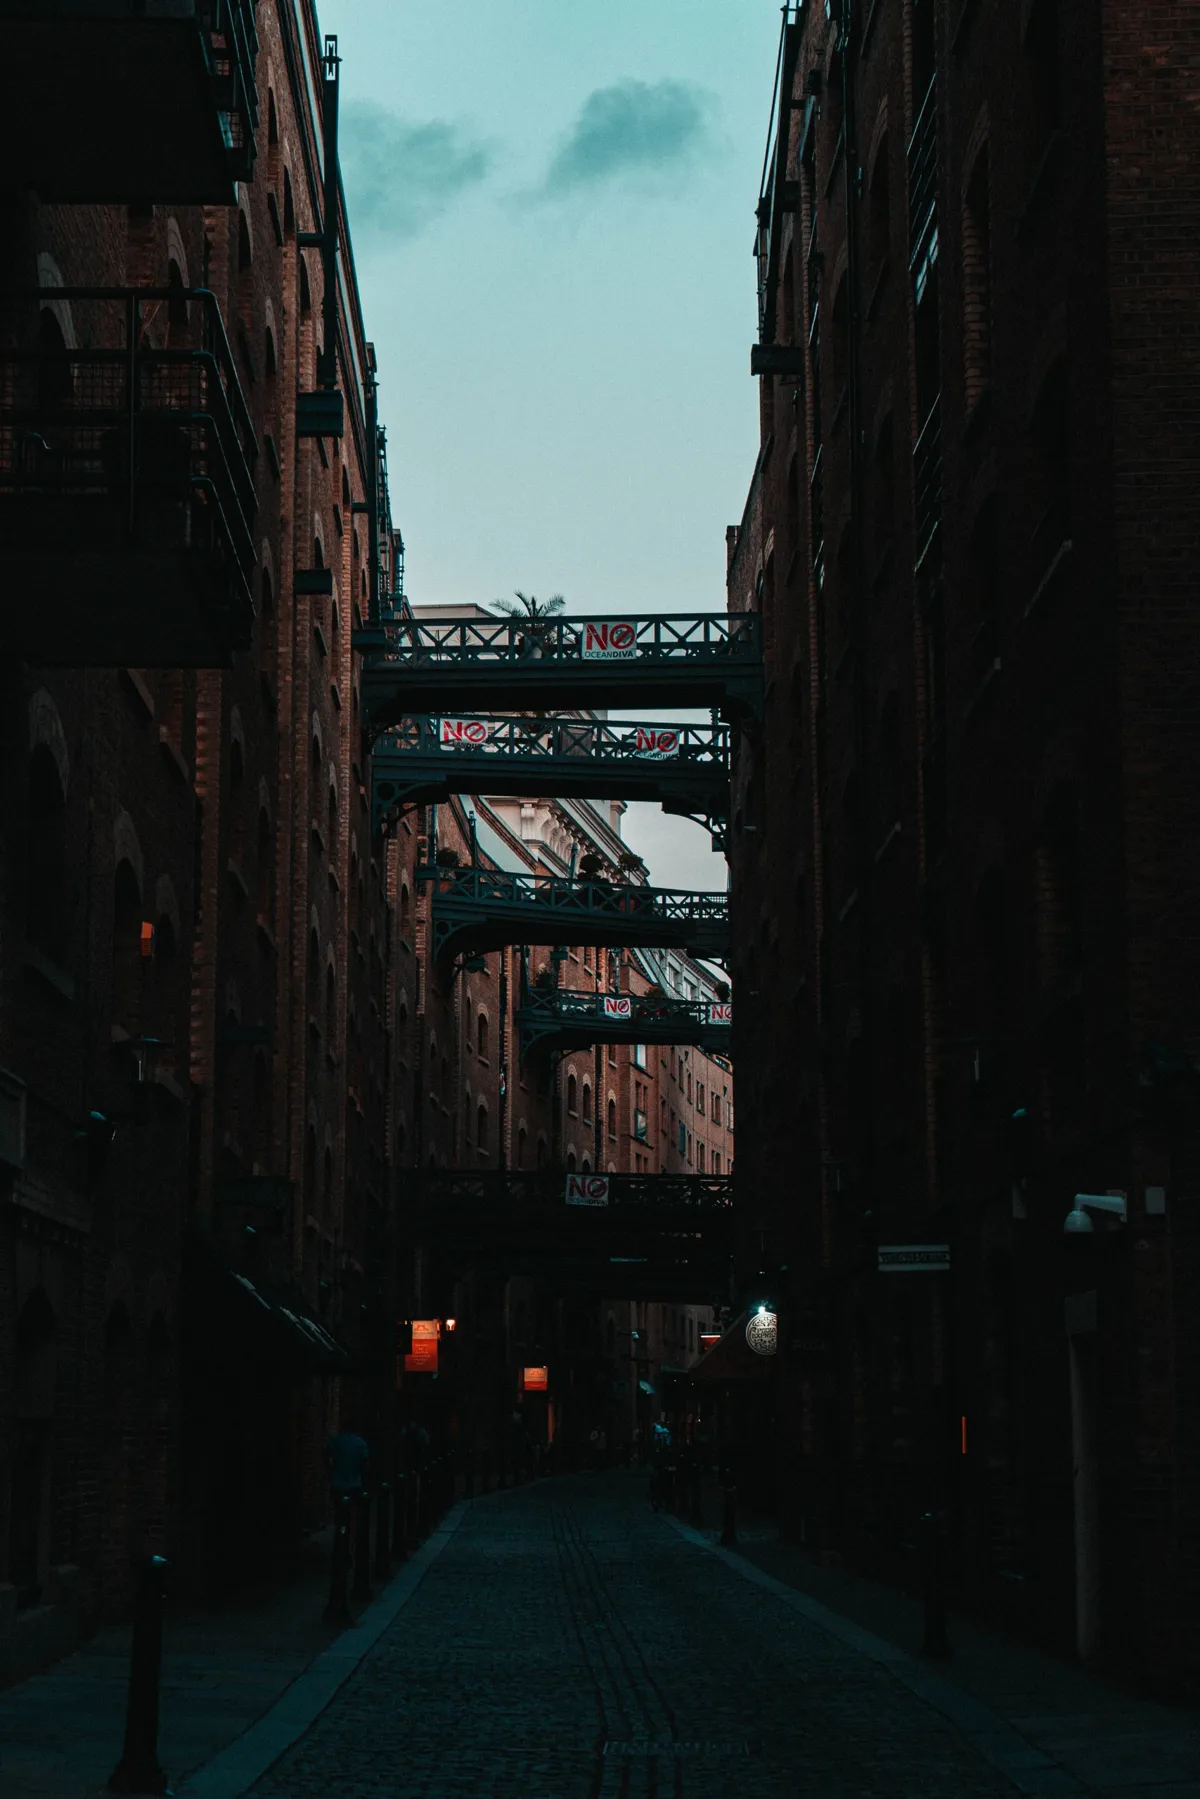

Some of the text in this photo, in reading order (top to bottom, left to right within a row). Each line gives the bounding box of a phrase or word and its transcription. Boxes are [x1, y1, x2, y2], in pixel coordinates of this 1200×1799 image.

[585, 623, 636, 650] NO
[584, 650, 634, 658] OCEANDIVA
[443, 720, 487, 743] NO
[636, 727, 678, 752] NO
[606, 998, 630, 1013] NO
[569, 1176, 607, 1198] NO
